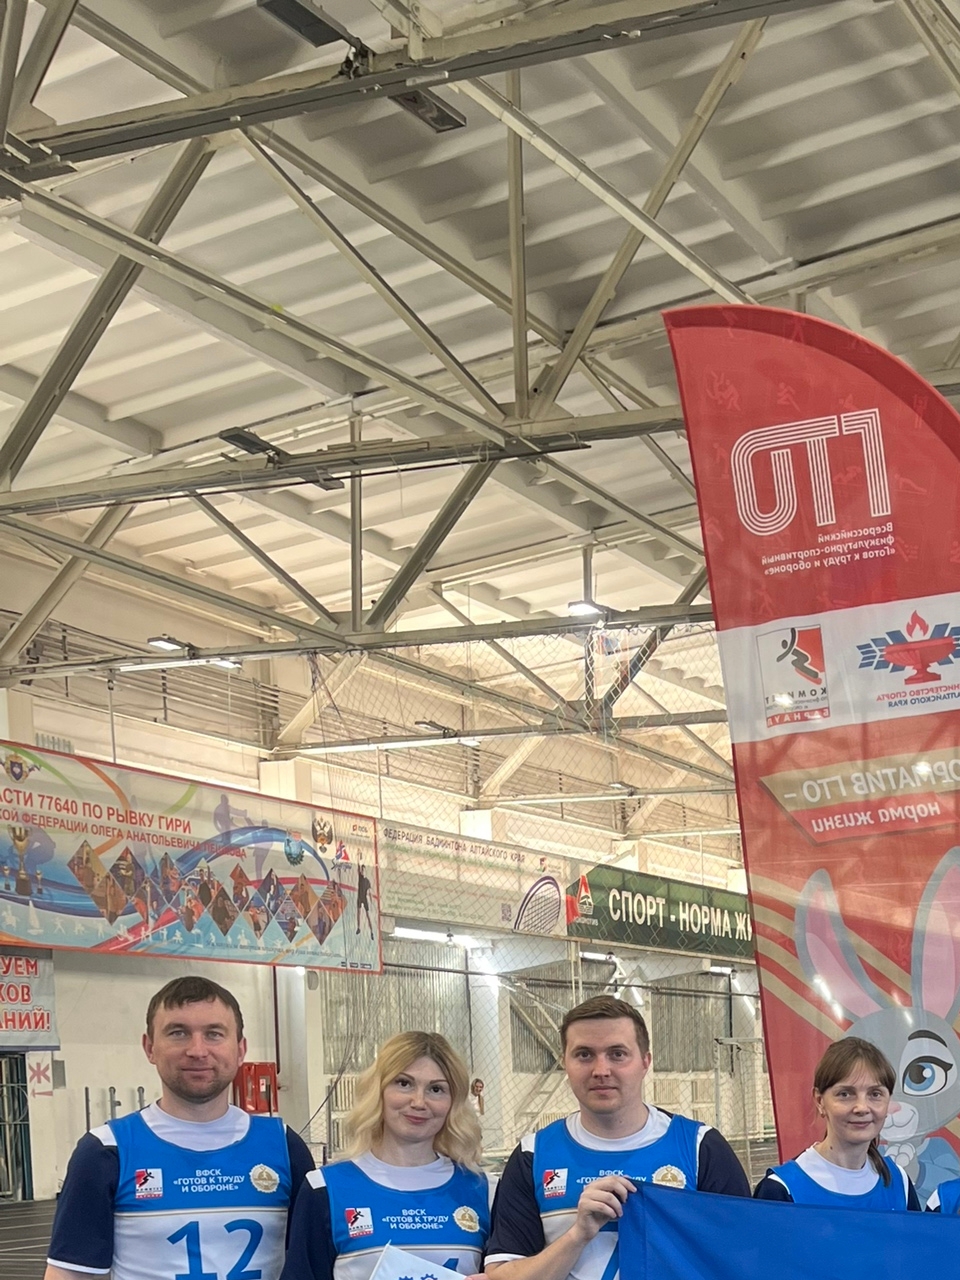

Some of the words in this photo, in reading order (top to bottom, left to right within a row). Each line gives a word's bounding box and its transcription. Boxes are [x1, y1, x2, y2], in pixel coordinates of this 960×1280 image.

[38, 794, 78, 815] 77640
[82, 802, 103, 819] ПО
[107, 806, 154, 828] РЫВКУ
[158, 815, 191, 834] ГИРИ
[22, 812, 88, 833] ФЕДЕРАЦИИ
[91, 824, 124, 839] ОЛЕГА
[126, 830, 201, 850] АНАТОЛЬЕВИЧА
[383, 828, 423, 844] ФЕДЕРАЦИЯ
[426, 836, 466, 853] БАДМИНТОНА
[469, 845, 508, 860] АЛТАЙСКОГО
[510, 850, 525, 863] КРАЯ
[608, 888, 666, 927] СПОРТ
[679, 901, 732, 939] НОРМА
[0, 1009, 51, 1030] НИЙ!
[28, 1062, 51, 1084] Ж
[173, 1177, 207, 1185] «ГОТОВ
[218, 1175, 245, 1184] ТРУДУ
[190, 1184, 239, 1193] ОБОРОНЕ»
[398, 1222, 443, 1230] ОБОРОНЕ»
[423, 1215, 449, 1223] ТРУДУ
